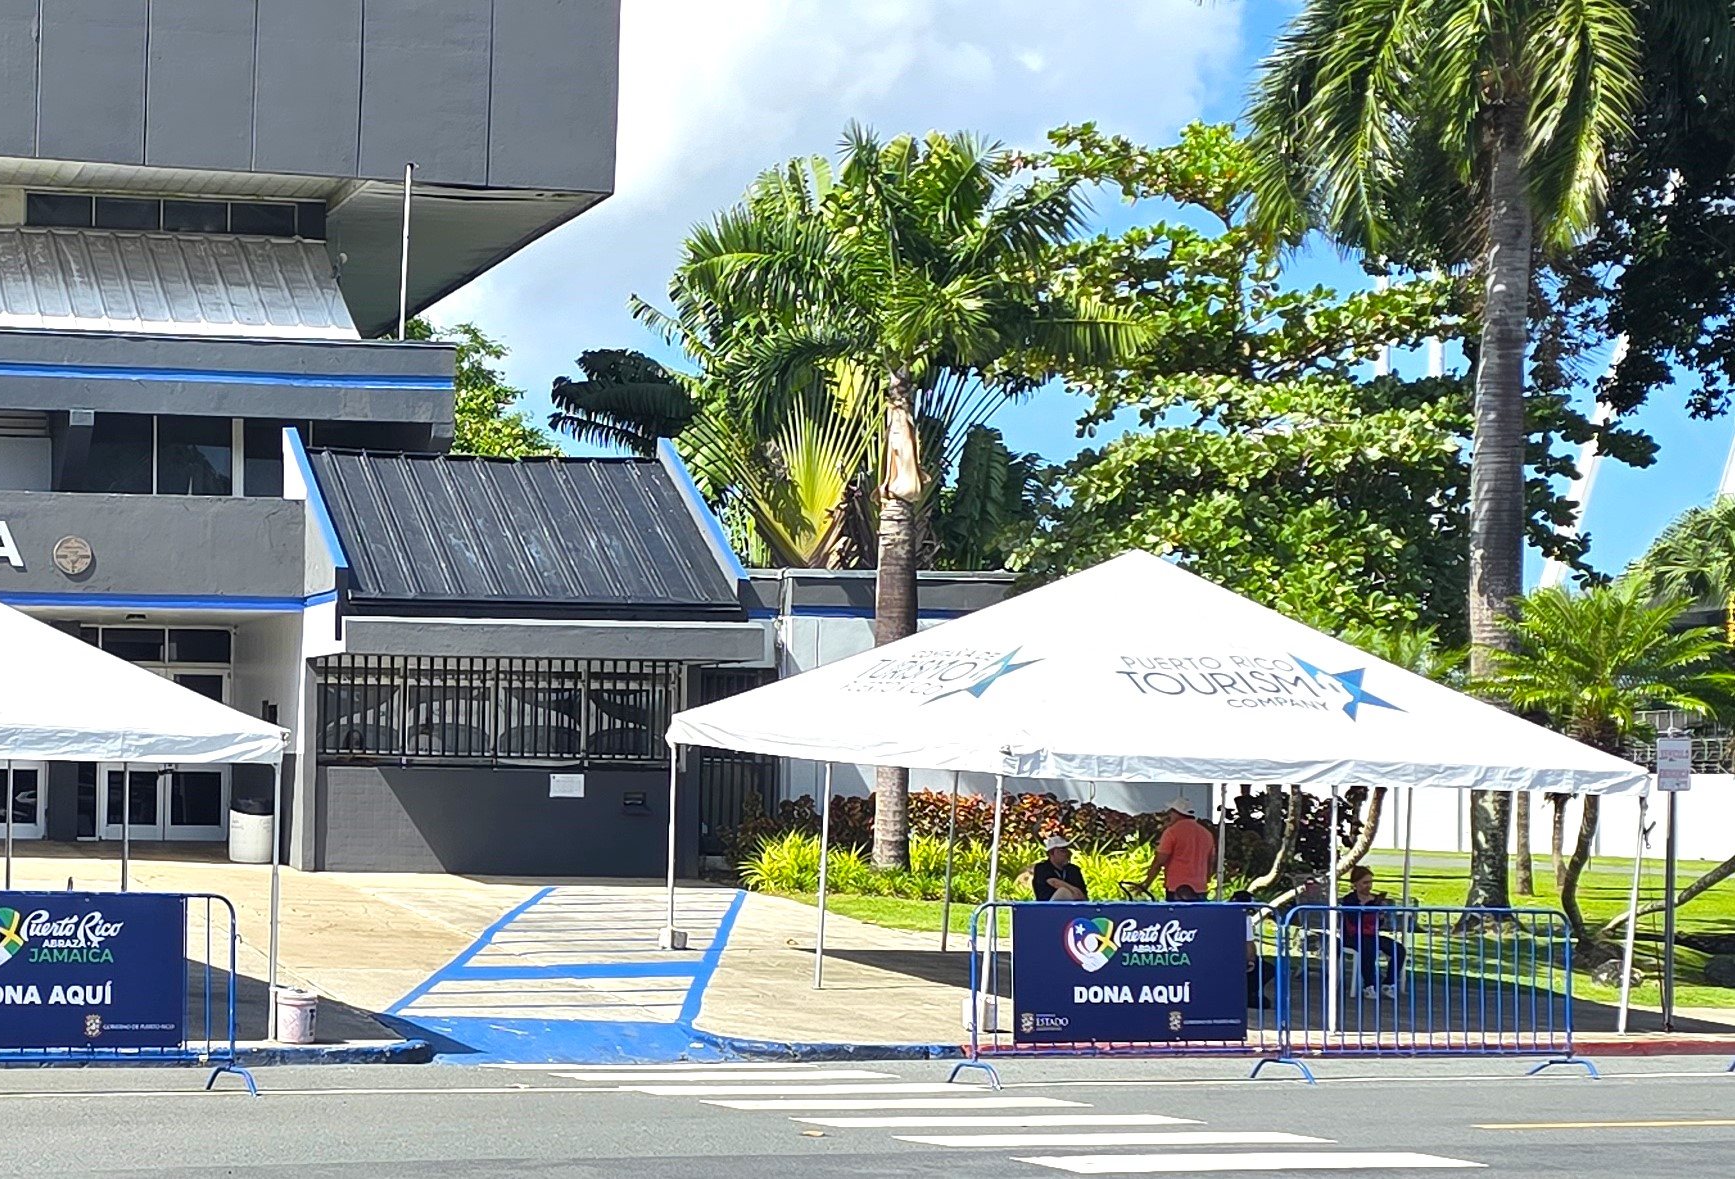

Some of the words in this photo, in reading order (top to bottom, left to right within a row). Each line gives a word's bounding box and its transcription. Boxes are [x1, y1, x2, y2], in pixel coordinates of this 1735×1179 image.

[1119, 655, 1222, 671] PUERTO
[1229, 655, 1294, 672] RICO
[1115, 670, 1321, 698] TOURISM
[1226, 697, 1330, 711] COMPANY
[19, 909, 79, 942] Puerto
[76, 911, 124, 942] Rico
[1113, 918, 1162, 948] Puerto
[1159, 919, 1198, 948] Rico
[28, 948, 114, 963] JAMAICA
[1121, 952, 1191, 966] JAMAICA
[48, 980, 113, 1007] AQUÍ
[1073, 985, 1134, 1004] DONA
[1138, 981, 1190, 1005] AQUÍ
